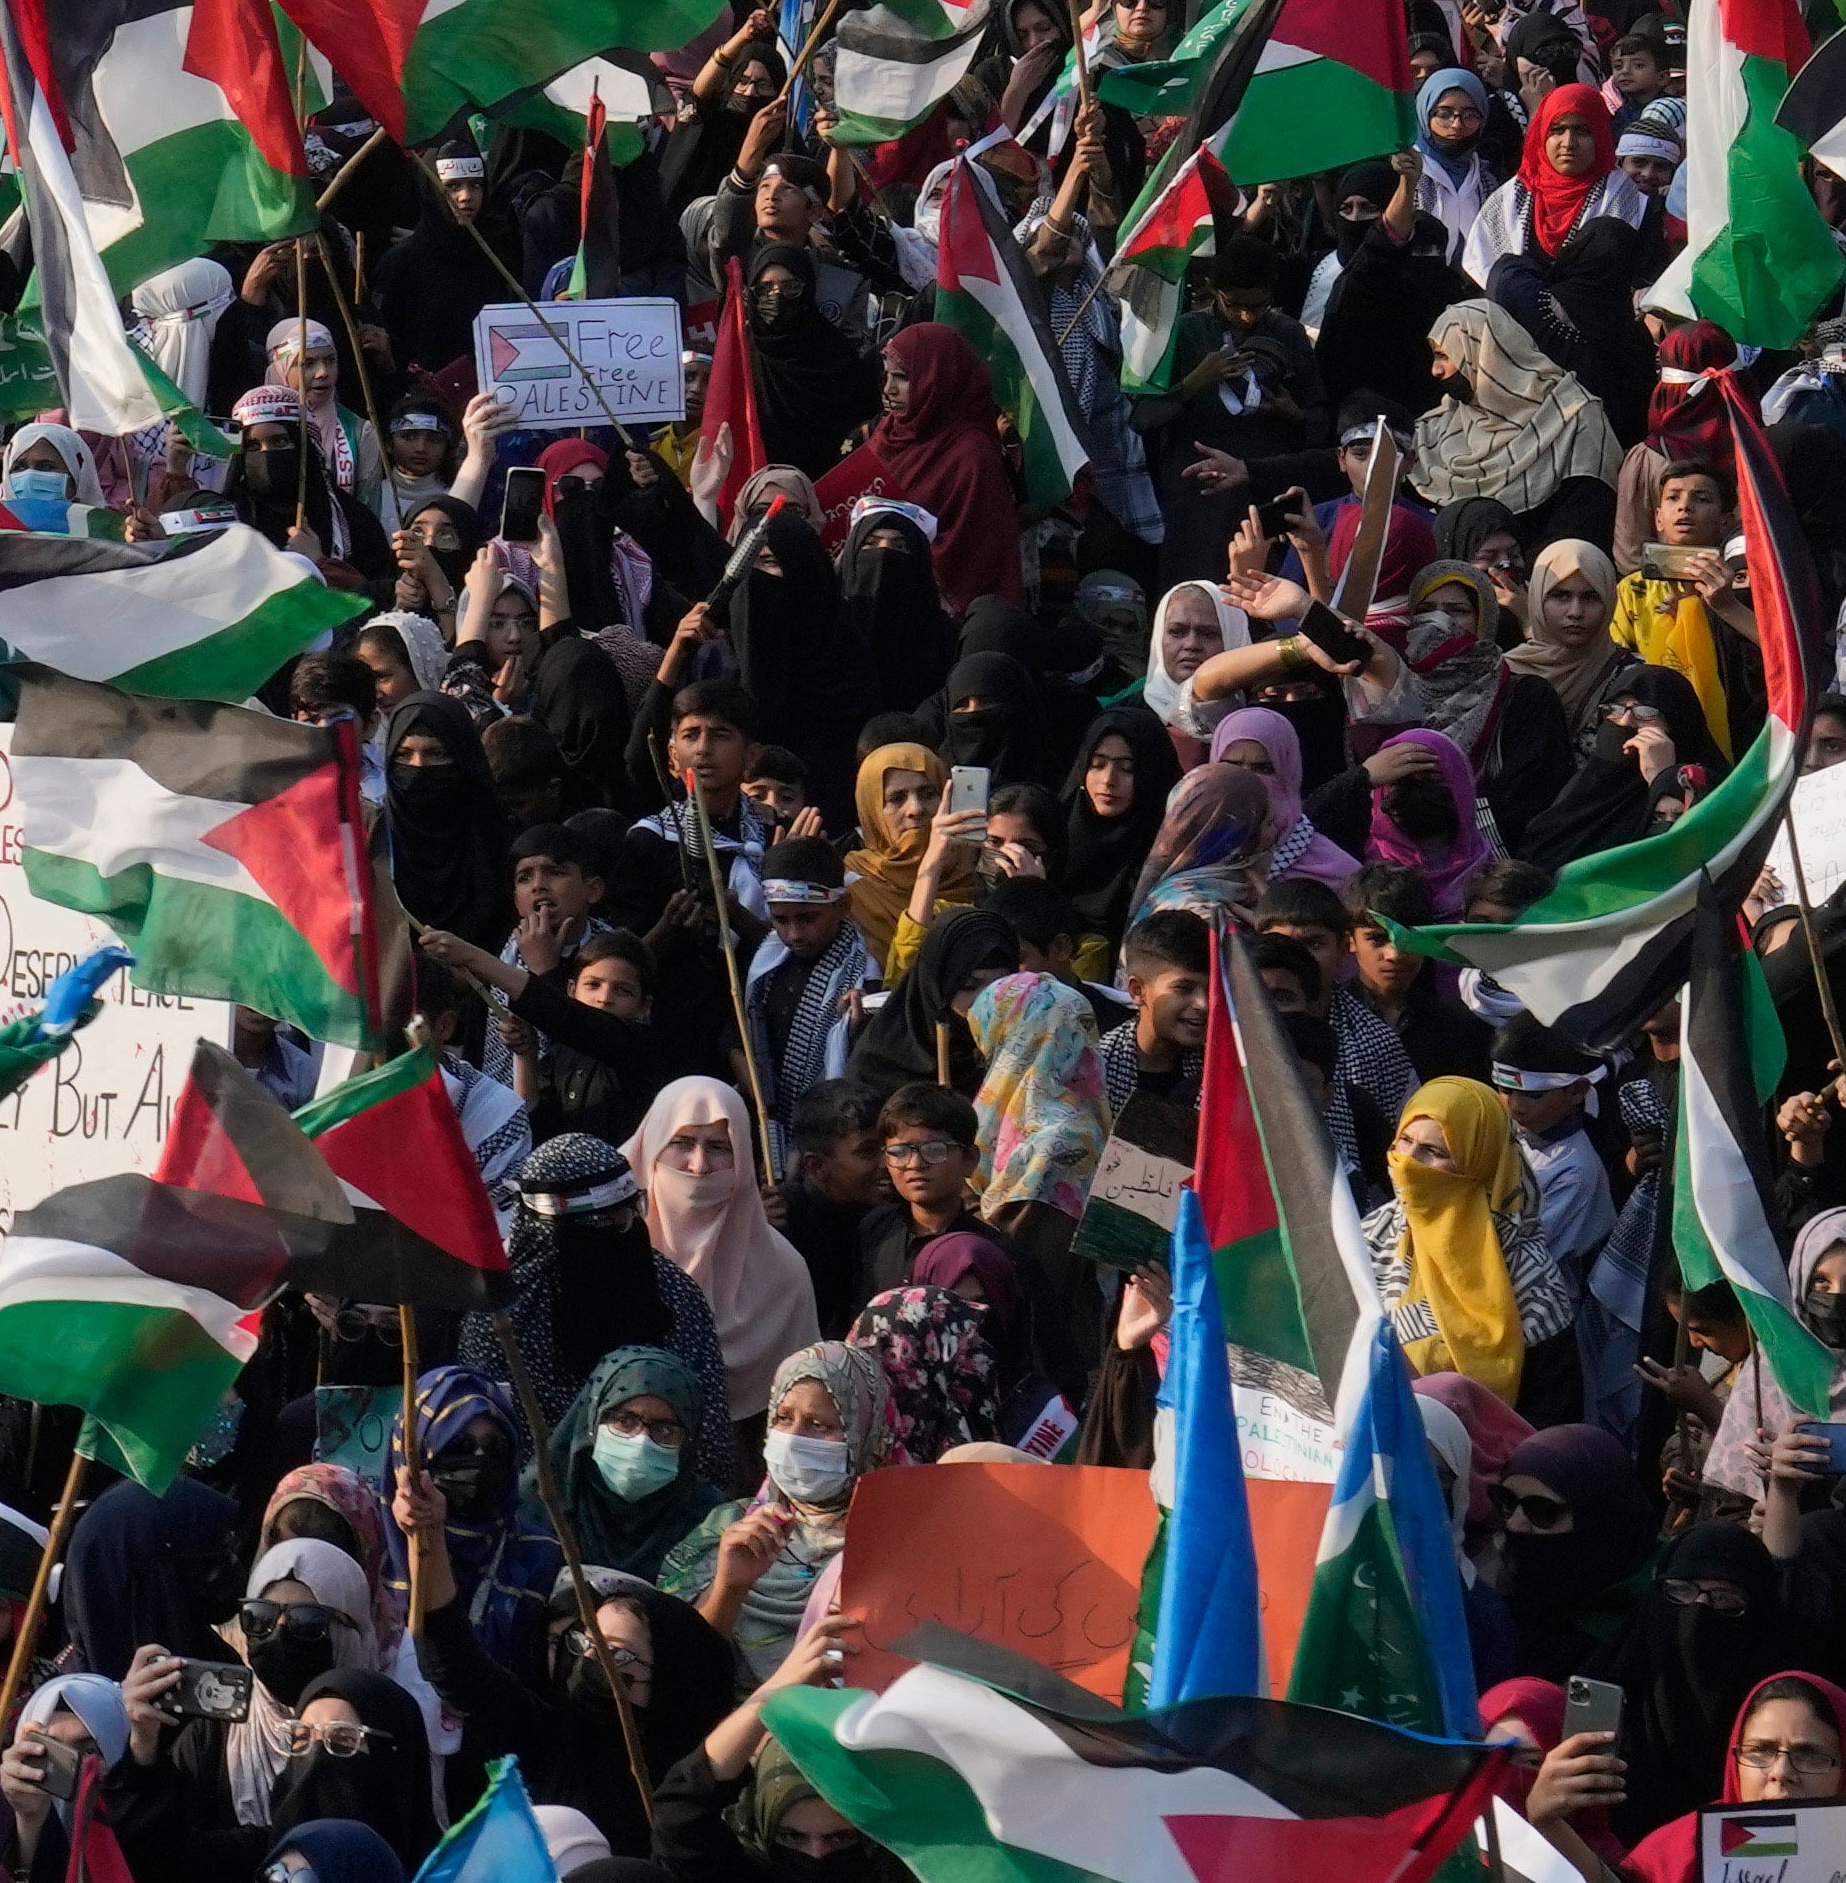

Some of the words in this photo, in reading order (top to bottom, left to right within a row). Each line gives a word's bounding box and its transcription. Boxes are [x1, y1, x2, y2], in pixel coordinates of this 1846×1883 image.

[577, 319, 671, 362] Free
[582, 364, 639, 386] Free
[494, 380, 669, 416] PALESTINE
[50, 1036, 118, 1137] BUT
[1260, 1396, 1296, 1424] END
[1292, 1409, 1329, 1445] THE
